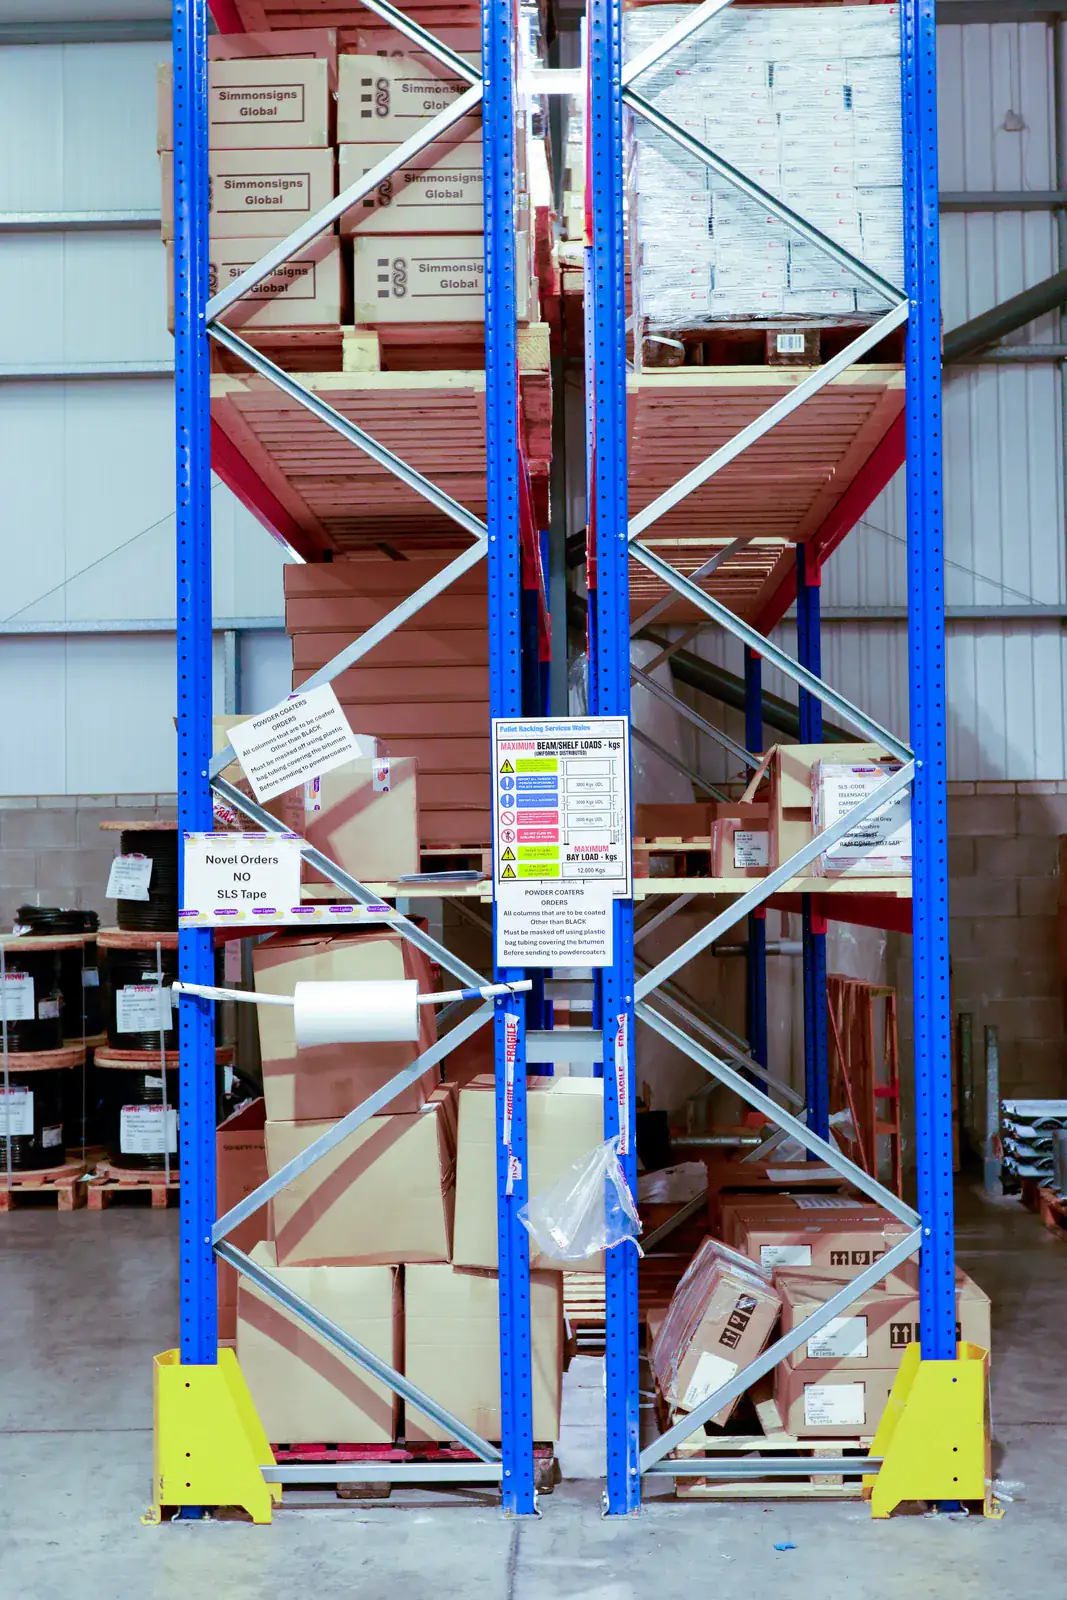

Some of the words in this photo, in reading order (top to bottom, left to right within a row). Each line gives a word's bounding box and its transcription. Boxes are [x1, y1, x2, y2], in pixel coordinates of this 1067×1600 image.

[219, 90, 297, 101] Simmonsigns
[240, 106, 277, 116] Global
[423, 101, 450, 110] Glob
[404, 173, 483, 184] Simmonsigns
[224, 179, 303, 190] Simmonsigns
[245, 195, 283, 205] Global
[425, 190, 463, 199] Global
[419, 263, 484, 274] Simmonsig
[251, 284, 288, 293] Global
[440, 279, 478, 288] Global
[253, 713, 280, 729] POWDER
[279, 699, 307, 716] COATERS
[272, 716, 296, 731] ORDERS
[243, 749, 251, 757] All
[251, 737, 277, 752] columns
[276, 731, 289, 739] that
[289, 726, 299, 734] are
[314, 708, 335, 721] coated
[270, 742, 287, 752] Other
[287, 735, 301, 744] than
[301, 724, 321, 738] BLACK
[251, 763, 266, 773] Must
[275, 747, 298, 762] masked
[306, 735, 323, 746] using
[323, 726, 343, 739] plastic
[500, 742, 535, 751] MAXIMUM
[537, 741, 578, 750] BEAM/SHELF
[580, 741, 602, 749] LOADS
[608, 741, 620, 750] kgs
[256, 773, 268, 782] bag
[267, 764, 287, 776] tubing
[287, 752, 312, 767] covering
[321, 736, 346, 750] bitumen
[259, 780, 279, 792] Before
[279, 768, 303, 782] sending
[574, 845, 609, 853] MAXIMUM
[205, 855, 238, 864] Novel
[241, 855, 279, 864] Orders
[581, 853, 598, 861] LOAD
[605, 853, 617, 862] kgs
[233, 872, 251, 881] NO
[217, 889, 238, 899] SLS
[241, 889, 267, 901] Tape
[507, 1023, 517, 1062] FRAGILE
